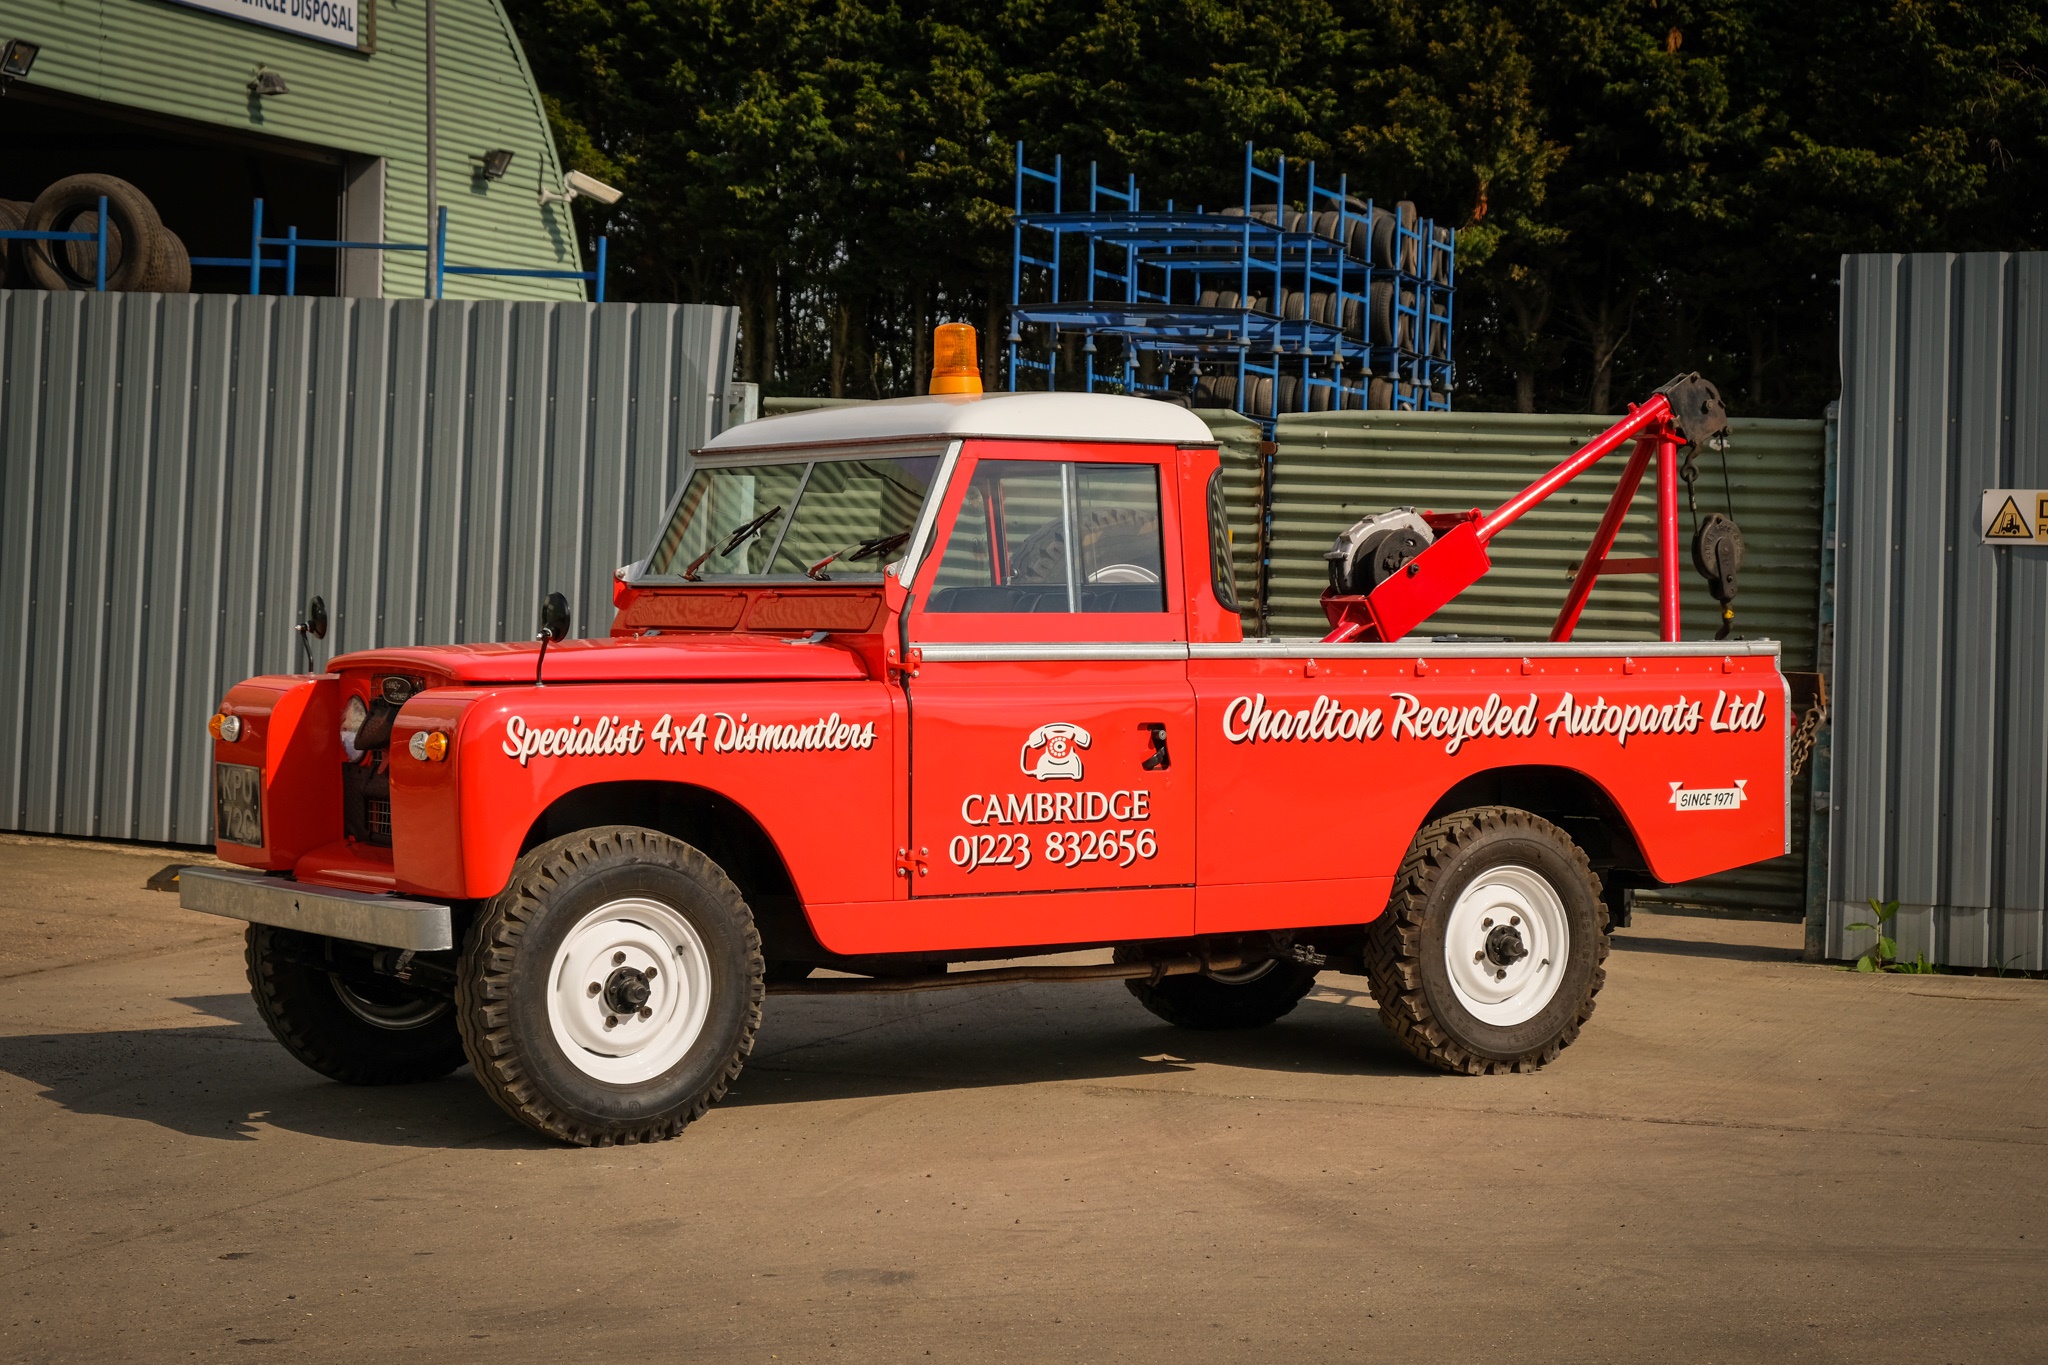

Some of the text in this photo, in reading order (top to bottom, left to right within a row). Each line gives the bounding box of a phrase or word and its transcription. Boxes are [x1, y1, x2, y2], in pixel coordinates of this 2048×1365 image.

[291, 0, 354, 32] DISPOSAL
[502, 711, 879, 768] Specialist 4x4 Dismantlers
[1222, 688, 1767, 756] Charlton Recycled Autoparts Ltd
[222, 767, 252, 803] KPU
[1680, 792, 1735, 807] SINCE 1971
[961, 789, 1151, 826] CAMBRIDGE
[948, 828, 1159, 874] 01223 832656
